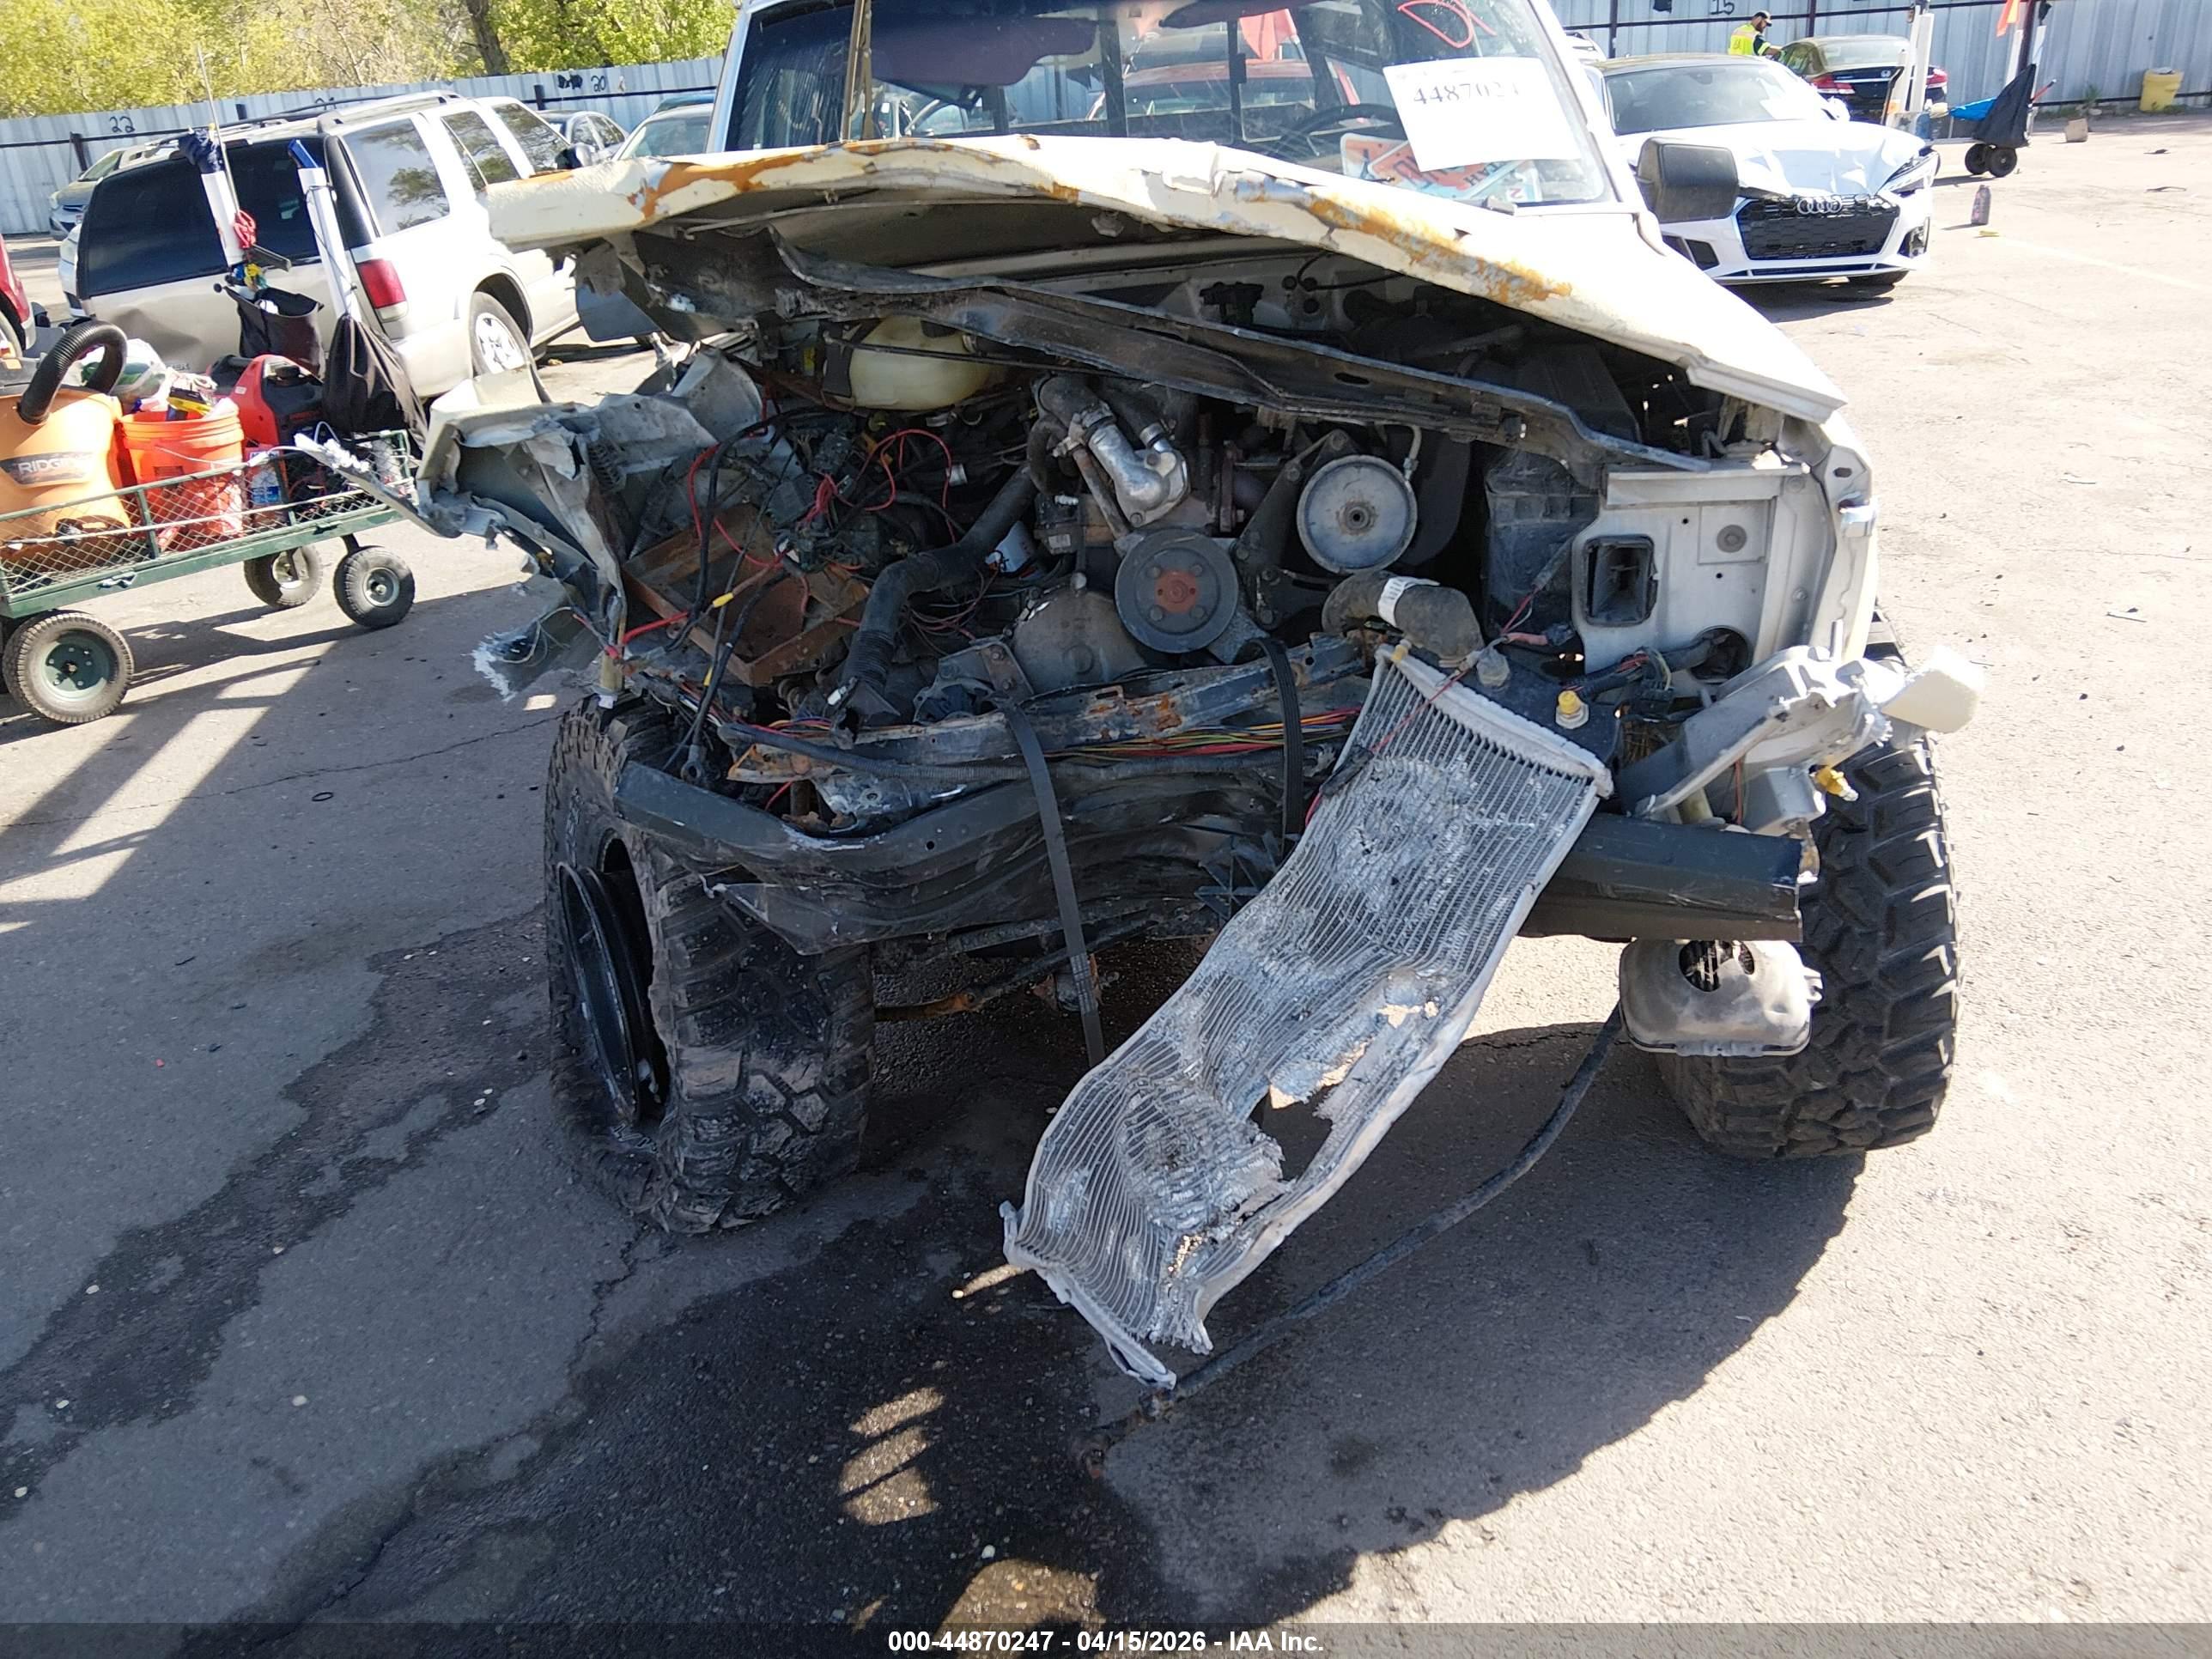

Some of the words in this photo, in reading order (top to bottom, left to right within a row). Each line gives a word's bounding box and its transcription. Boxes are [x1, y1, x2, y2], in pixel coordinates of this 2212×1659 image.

[1710, 0, 1735, 15] 15
[590, 74, 606, 93] 20
[108, 115, 136, 133] 22
